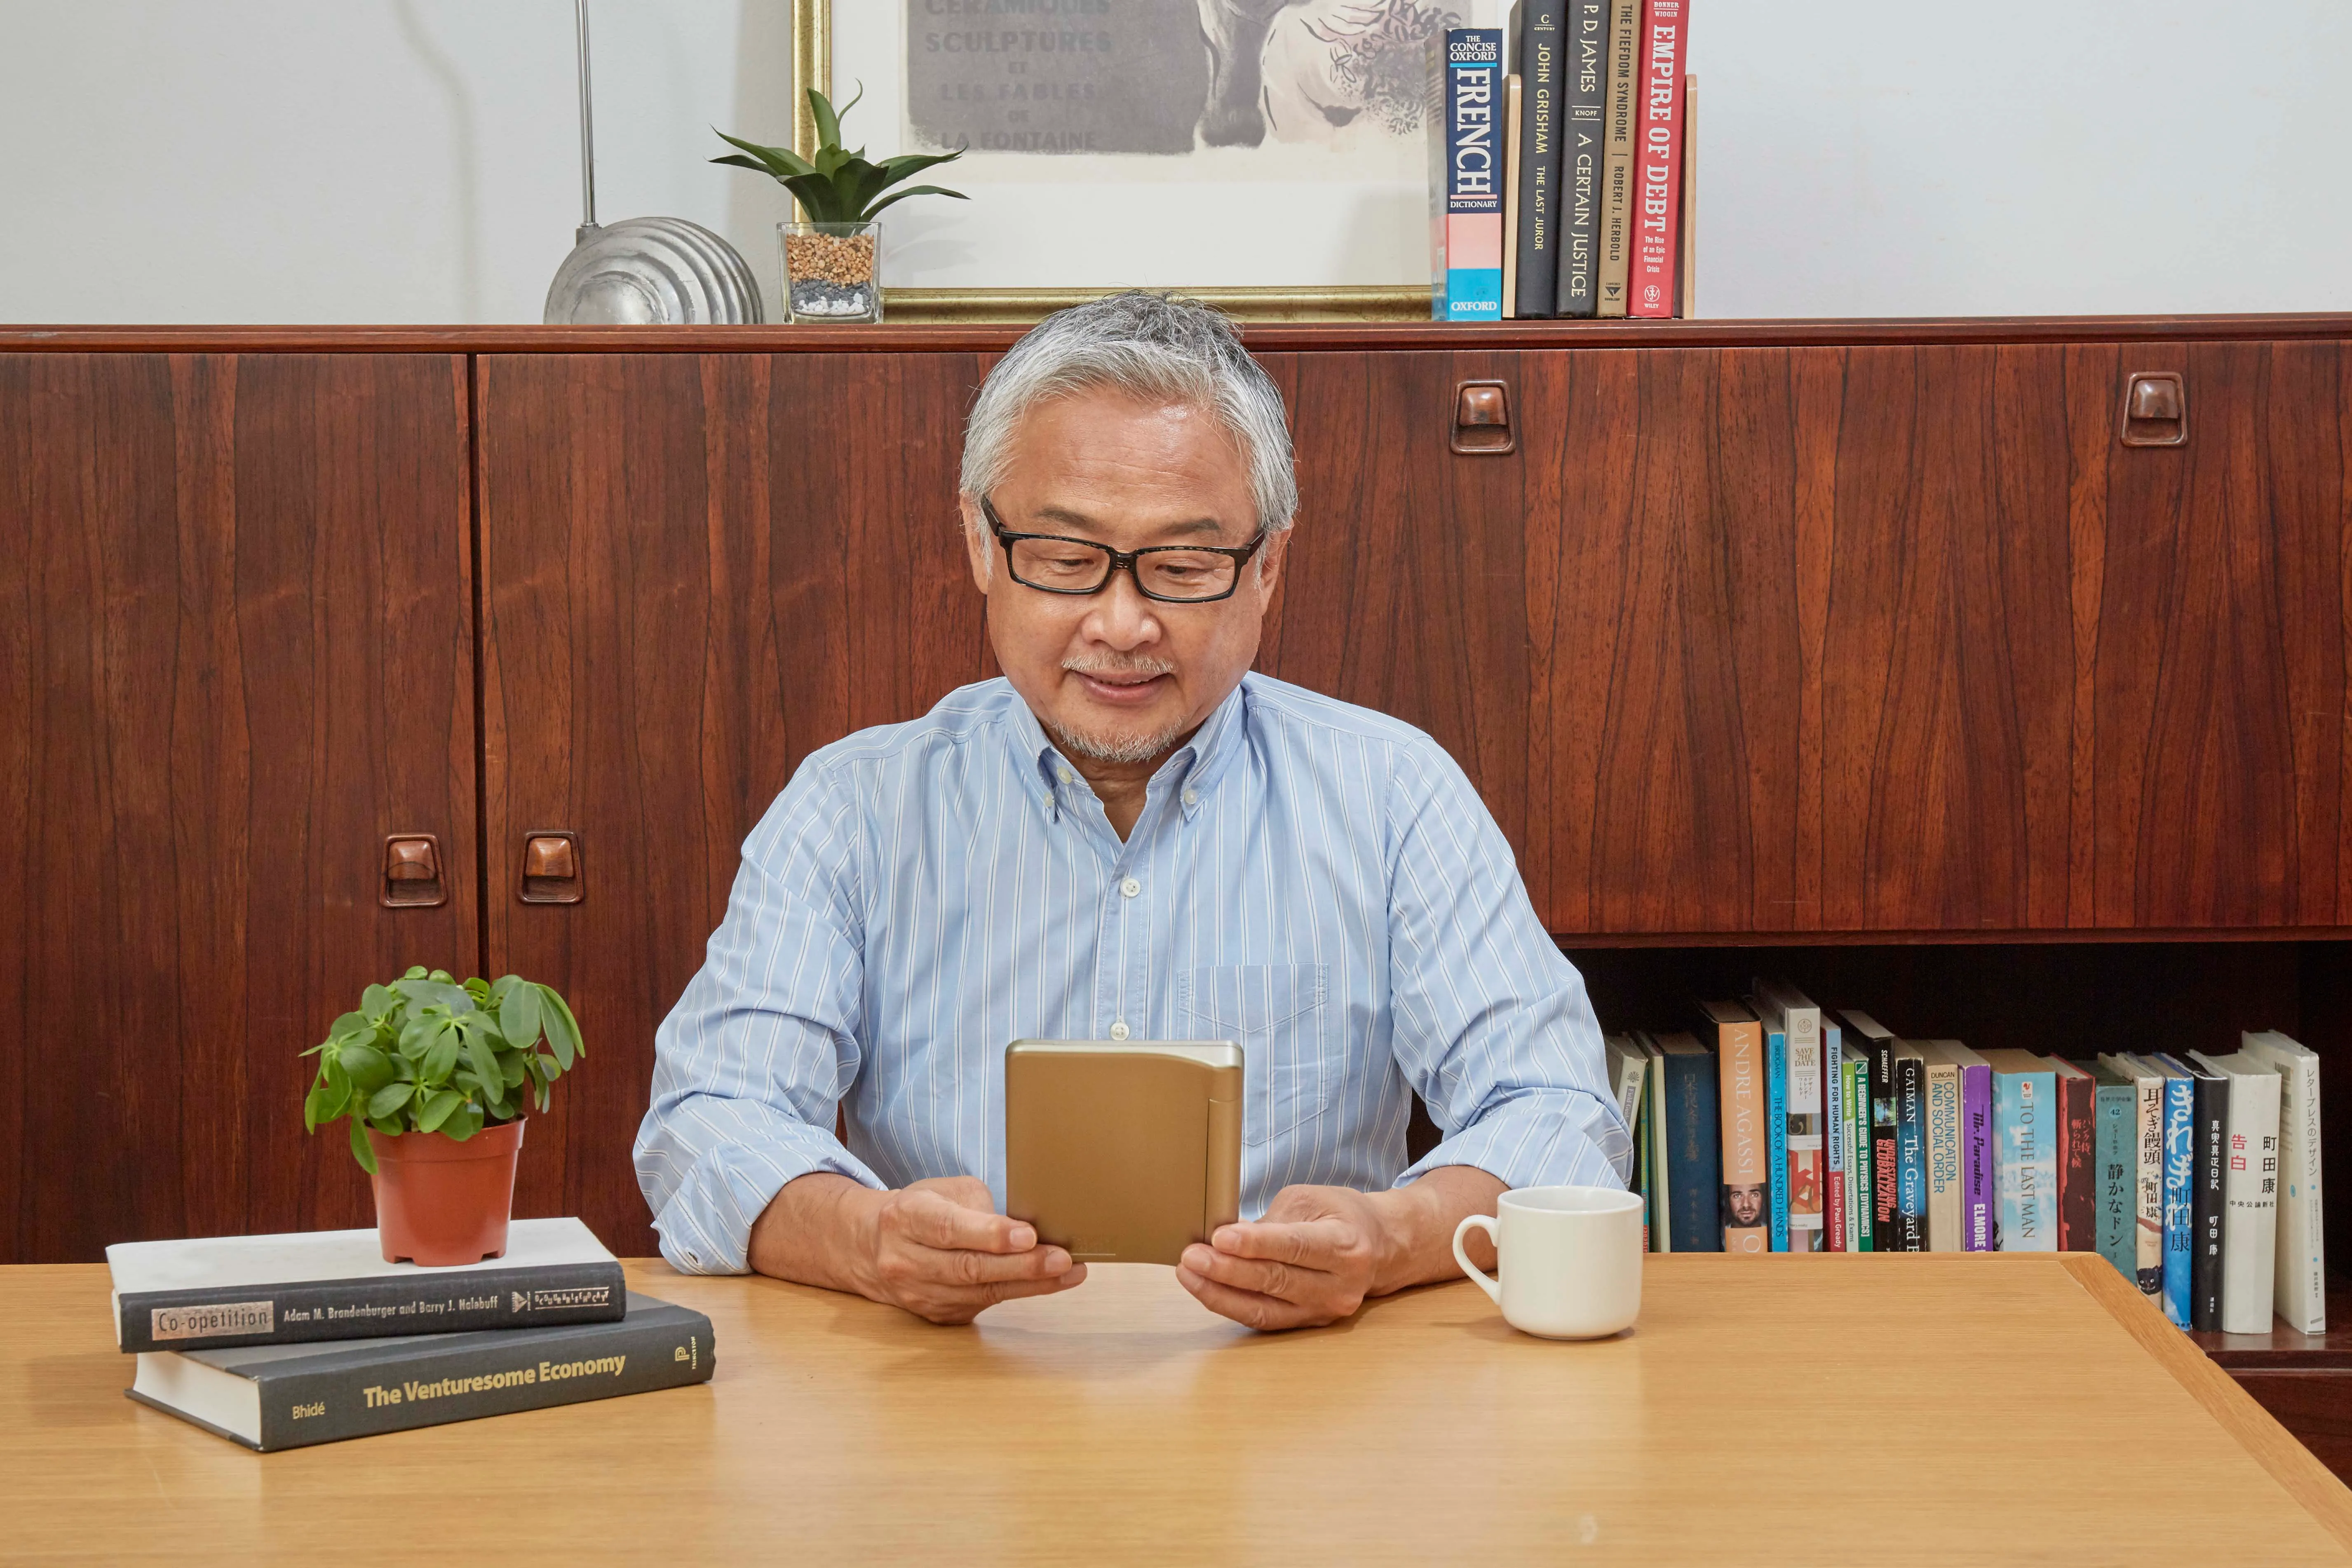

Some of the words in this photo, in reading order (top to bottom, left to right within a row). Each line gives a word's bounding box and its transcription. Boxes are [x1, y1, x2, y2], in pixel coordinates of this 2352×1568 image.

[1541, 14, 1549, 23] C
[1583, 20, 1598, 34] D.
[1584, 5, 1599, 14] P.
[1620, 5, 1632, 24] THE
[926, 31, 1111, 52] SCULPTURES
[1450, 42, 1496, 51] CONCISE
[1450, 52, 1496, 61] OXFORD
[1617, 29, 1631, 78] FIEFDOM
[1008, 61, 1028, 73] ET
[1537, 43, 1550, 82] JOHN
[1580, 38, 1597, 92] JAMES
[1650, 25, 1675, 120] EMPIRE
[941, 83, 985, 101] LES
[999, 83, 1096, 101] FABLES
[1008, 110, 1029, 123] DE
[1455, 68, 1490, 193] FRENCH
[1536, 89, 1549, 153] GRISHAM
[1615, 82, 1628, 142] SYNDROME
[941, 132, 970, 149] LA
[981, 131, 1096, 149] FONTAINE
[1578, 133, 1592, 147] A
[1648, 127, 1670, 159] OF
[1537, 166, 1545, 185] THE
[1574, 154, 1591, 225] CERTAIN
[1613, 166, 1624, 204] ROBERT
[1536, 190, 1545, 214] LAST
[1645, 165, 1669, 232] DEBT
[1535, 217, 1544, 250] JUROR
[1610, 218, 1621, 261] HERBOLD
[1571, 232, 1588, 297] JUSTICE
[1451, 301, 1497, 311] OXFORD
[1735, 1028, 1751, 1099] ANDRE
[1774, 1096, 1782, 1112] THE
[1858, 1084, 1867, 1126] BEGINNER'S
[1906, 1068, 1916, 1122] GAIMAN
[1932, 1083, 1943, 1106] AND
[2020, 1102, 2034, 1124] TO
[1774, 1114, 1782, 1140] BOOK
[1859, 1127, 1867, 1148] GUIDE
[1932, 1110, 1944, 1152] SOCIAL
[1944, 1082, 1956, 1181] COMMUNICATION
[1973, 1105, 1984, 1134] Mr.
[2143, 1087, 2162, 1165] 耳そぎ饅頭
[1737, 1105, 1753, 1174] AGASSI
[1774, 1141, 1783, 1152] OF
[1859, 1149, 1868, 1159] TO
[1904, 1135, 1919, 1163] The
[2021, 1129, 2034, 1161] THE
[2165, 1085, 2194, 1231] きれぎれ
[2211, 1120, 2220, 1191] 真実真正日記
[2231, 1134, 2247, 1171] 告白
[1775, 1163, 1783, 1204] HUNDRED
[1859, 1160, 1868, 1191] PHYSICS
[1876, 1139, 1890, 1222] GLOBALIZATION
[1886, 1139, 1897, 1209] UNDERSTANDING
[1933, 1153, 1945, 1193] ORDER
[1973, 1136, 1984, 1196] Paradise
[2021, 1167, 2035, 1199] LAST
[2262, 1136, 2277, 1194] 町田康
[1860, 1193, 1870, 1237] [DYNAMICS]
[1902, 1168, 1920, 1240] Graveyard
[2107, 1164, 2124, 1246] 静かなドン
[2145, 1181, 2157, 1218] 町田康
[1776, 1207, 1784, 1237] HANDS
[1974, 1204, 1986, 1247] ELMORE
[2021, 1204, 2035, 1238] MAN
[2171, 1187, 2191, 1252] 町田康
[2209, 1216, 2218, 1256] 町田康
[159, 1308, 267, 1333] Co-opetition
[284, 1308, 310, 1322] Adam
[313, 1308, 324, 1320] M.
[328, 1304, 396, 1318] Brandenburger
[399, 1301, 416, 1314] and
[420, 1301, 445, 1315] Barry
[447, 1300, 455, 1311] J.
[459, 1296, 498, 1310] Nalebuff
[363, 1386, 402, 1408] The
[404, 1367, 535, 1401] Venturesome
[539, 1355, 626, 1382] Economy
[292, 1402, 325, 1419] Bhidé
